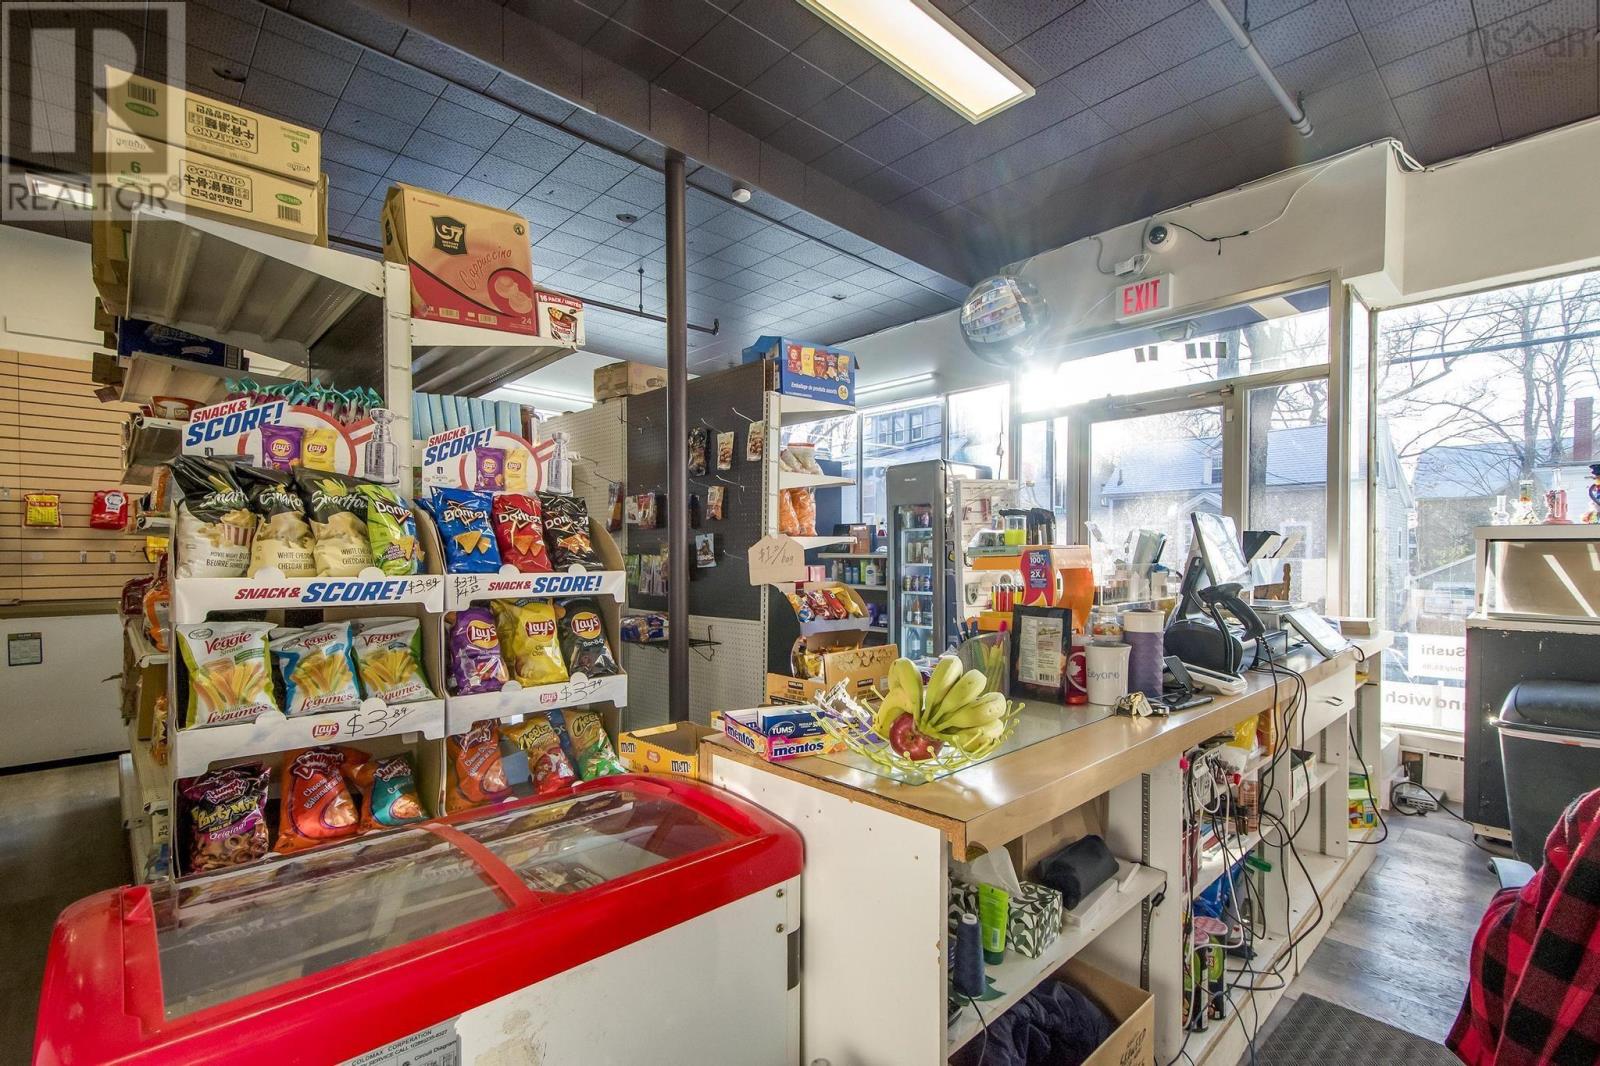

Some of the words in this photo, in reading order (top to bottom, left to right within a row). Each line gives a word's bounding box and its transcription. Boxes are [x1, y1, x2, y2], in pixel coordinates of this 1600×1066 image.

[131, 161, 141, 174] 6
[459, 244, 513, 291] Cappuccino
[1121, 279, 1161, 316] EXIT
[520, 317, 532, 325] 24
[185, 400, 285, 447] SCORE!
[424, 428, 493, 467] SCORE!
[277, 551, 294, 560] WHITE
[340, 548, 357, 556] WHITE
[206, 559, 229, 568] BEURRE
[277, 562, 302, 571] CHEDDAR
[300, 581, 408, 603] SCORE!
[532, 575, 603, 594] SCORE!
[469, 624, 497, 643] Lay's
[527, 620, 555, 637] Lay's
[574, 615, 600, 634] Lay's
[205, 632, 252, 655] Veggie
[727, 725, 756, 750] mentos
[772, 725, 794, 735] TUMS
[773, 741, 825, 757] mentos
[209, 820, 248, 840] Original
